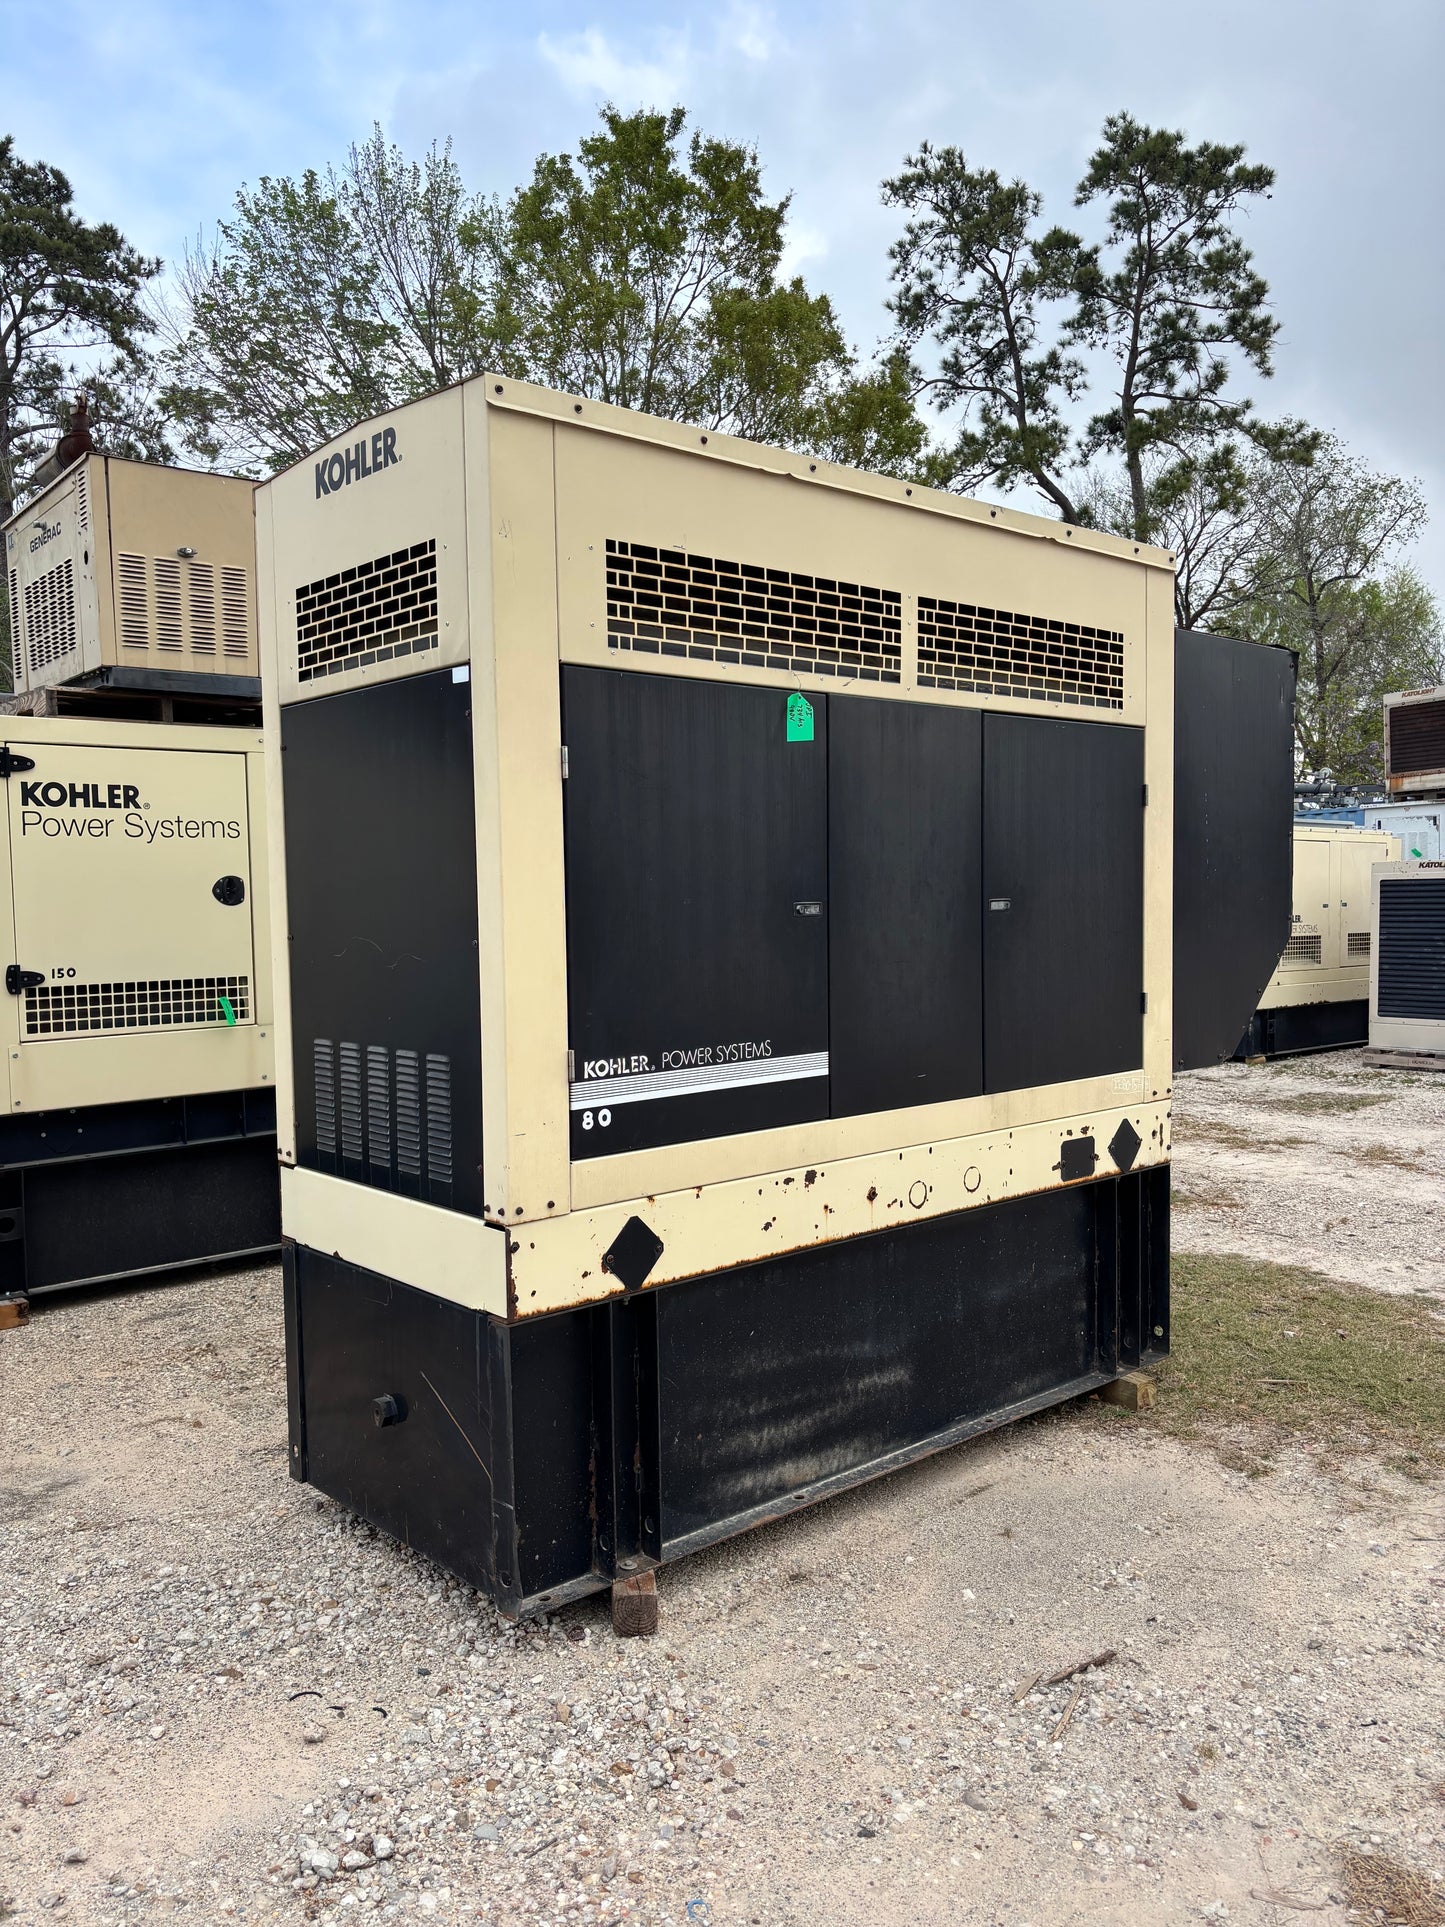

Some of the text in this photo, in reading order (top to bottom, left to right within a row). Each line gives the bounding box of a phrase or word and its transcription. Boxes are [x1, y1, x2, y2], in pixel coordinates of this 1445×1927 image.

[30, 521, 62, 553] GENERAC
[22, 811, 241, 844] Power Systems
[1418, 861, 1445, 869] KATOL
[51, 967, 77, 979] 150
[662, 1047, 713, 1069] POWER
[716, 1039, 772, 1063] SYSTEMS
[581, 1108, 612, 1130] 80
